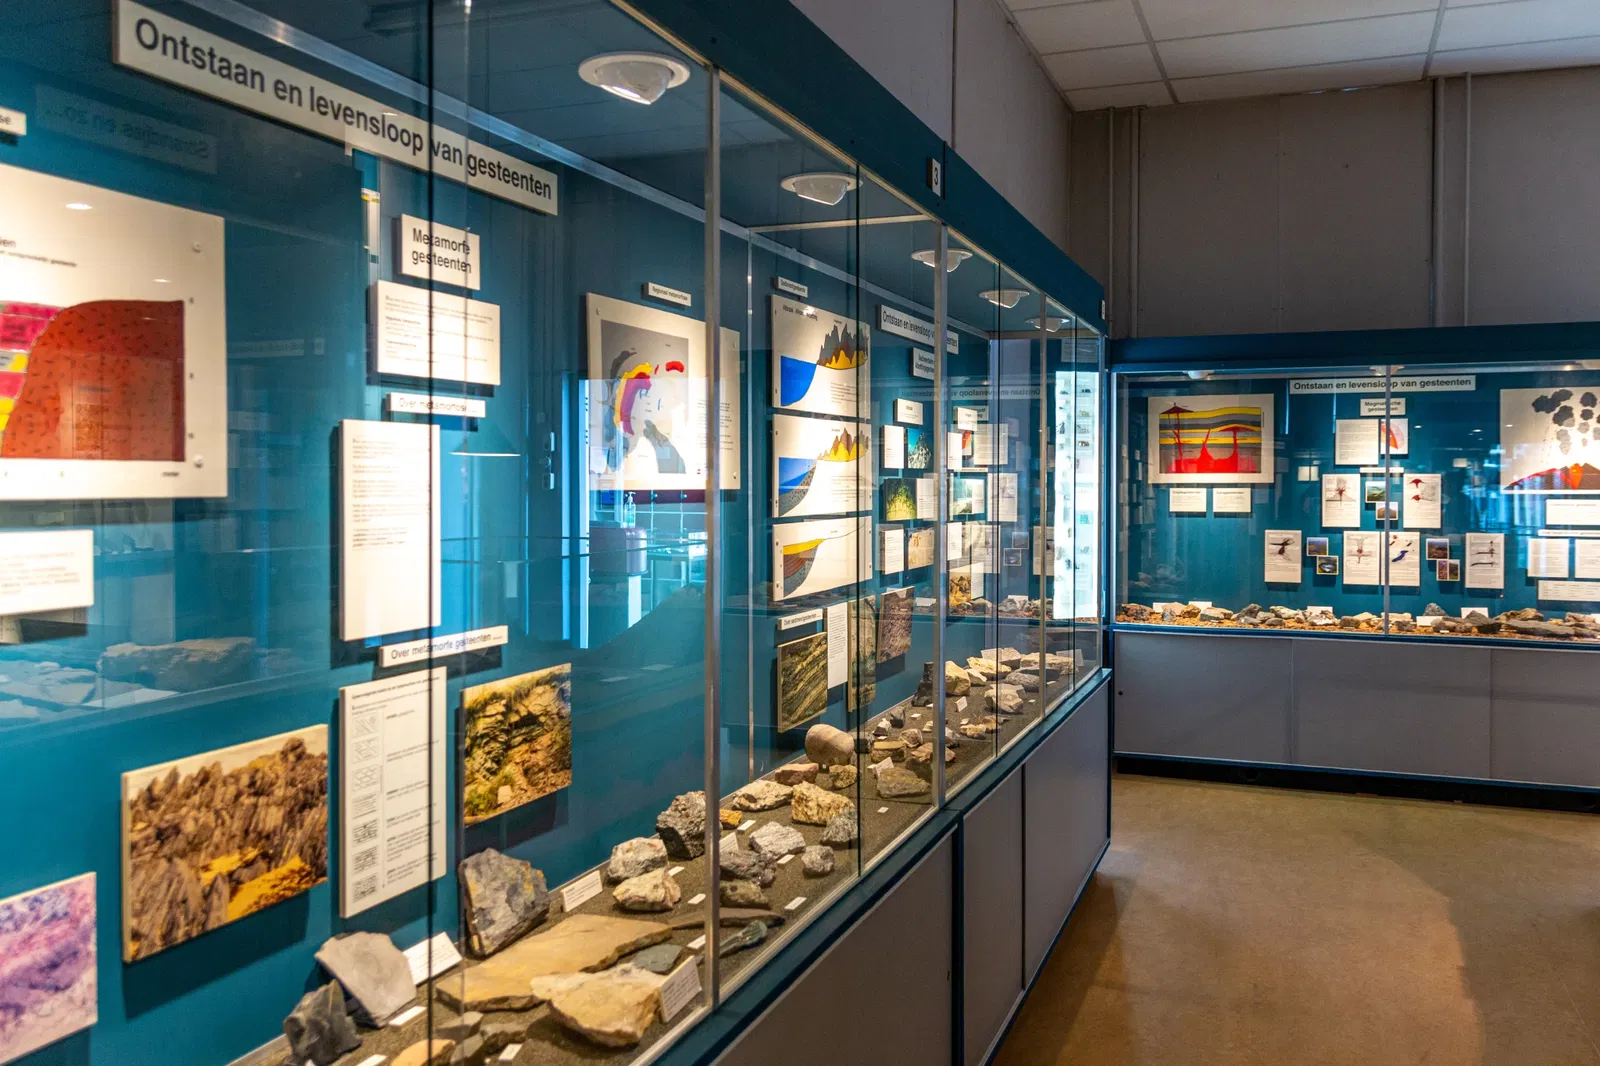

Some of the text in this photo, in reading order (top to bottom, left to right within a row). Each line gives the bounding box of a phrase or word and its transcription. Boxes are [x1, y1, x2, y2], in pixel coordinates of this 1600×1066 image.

[136, 17, 552, 200] Ontstaan en levensloop van gesteenten
[933, 166, 939, 186] 3
[412, 227, 471, 256] Metamorfe
[412, 250, 472, 274] gesteenten
[882, 311, 903, 328] Ontstaan
[1293, 381, 1334, 391] Ontstaan
[1349, 379, 1398, 390] levenslop
[1401, 380, 1417, 388] van
[1419, 378, 1471, 389] gesteenten
[390, 648, 410, 660] Over
[412, 640, 454, 655] metamorfe
